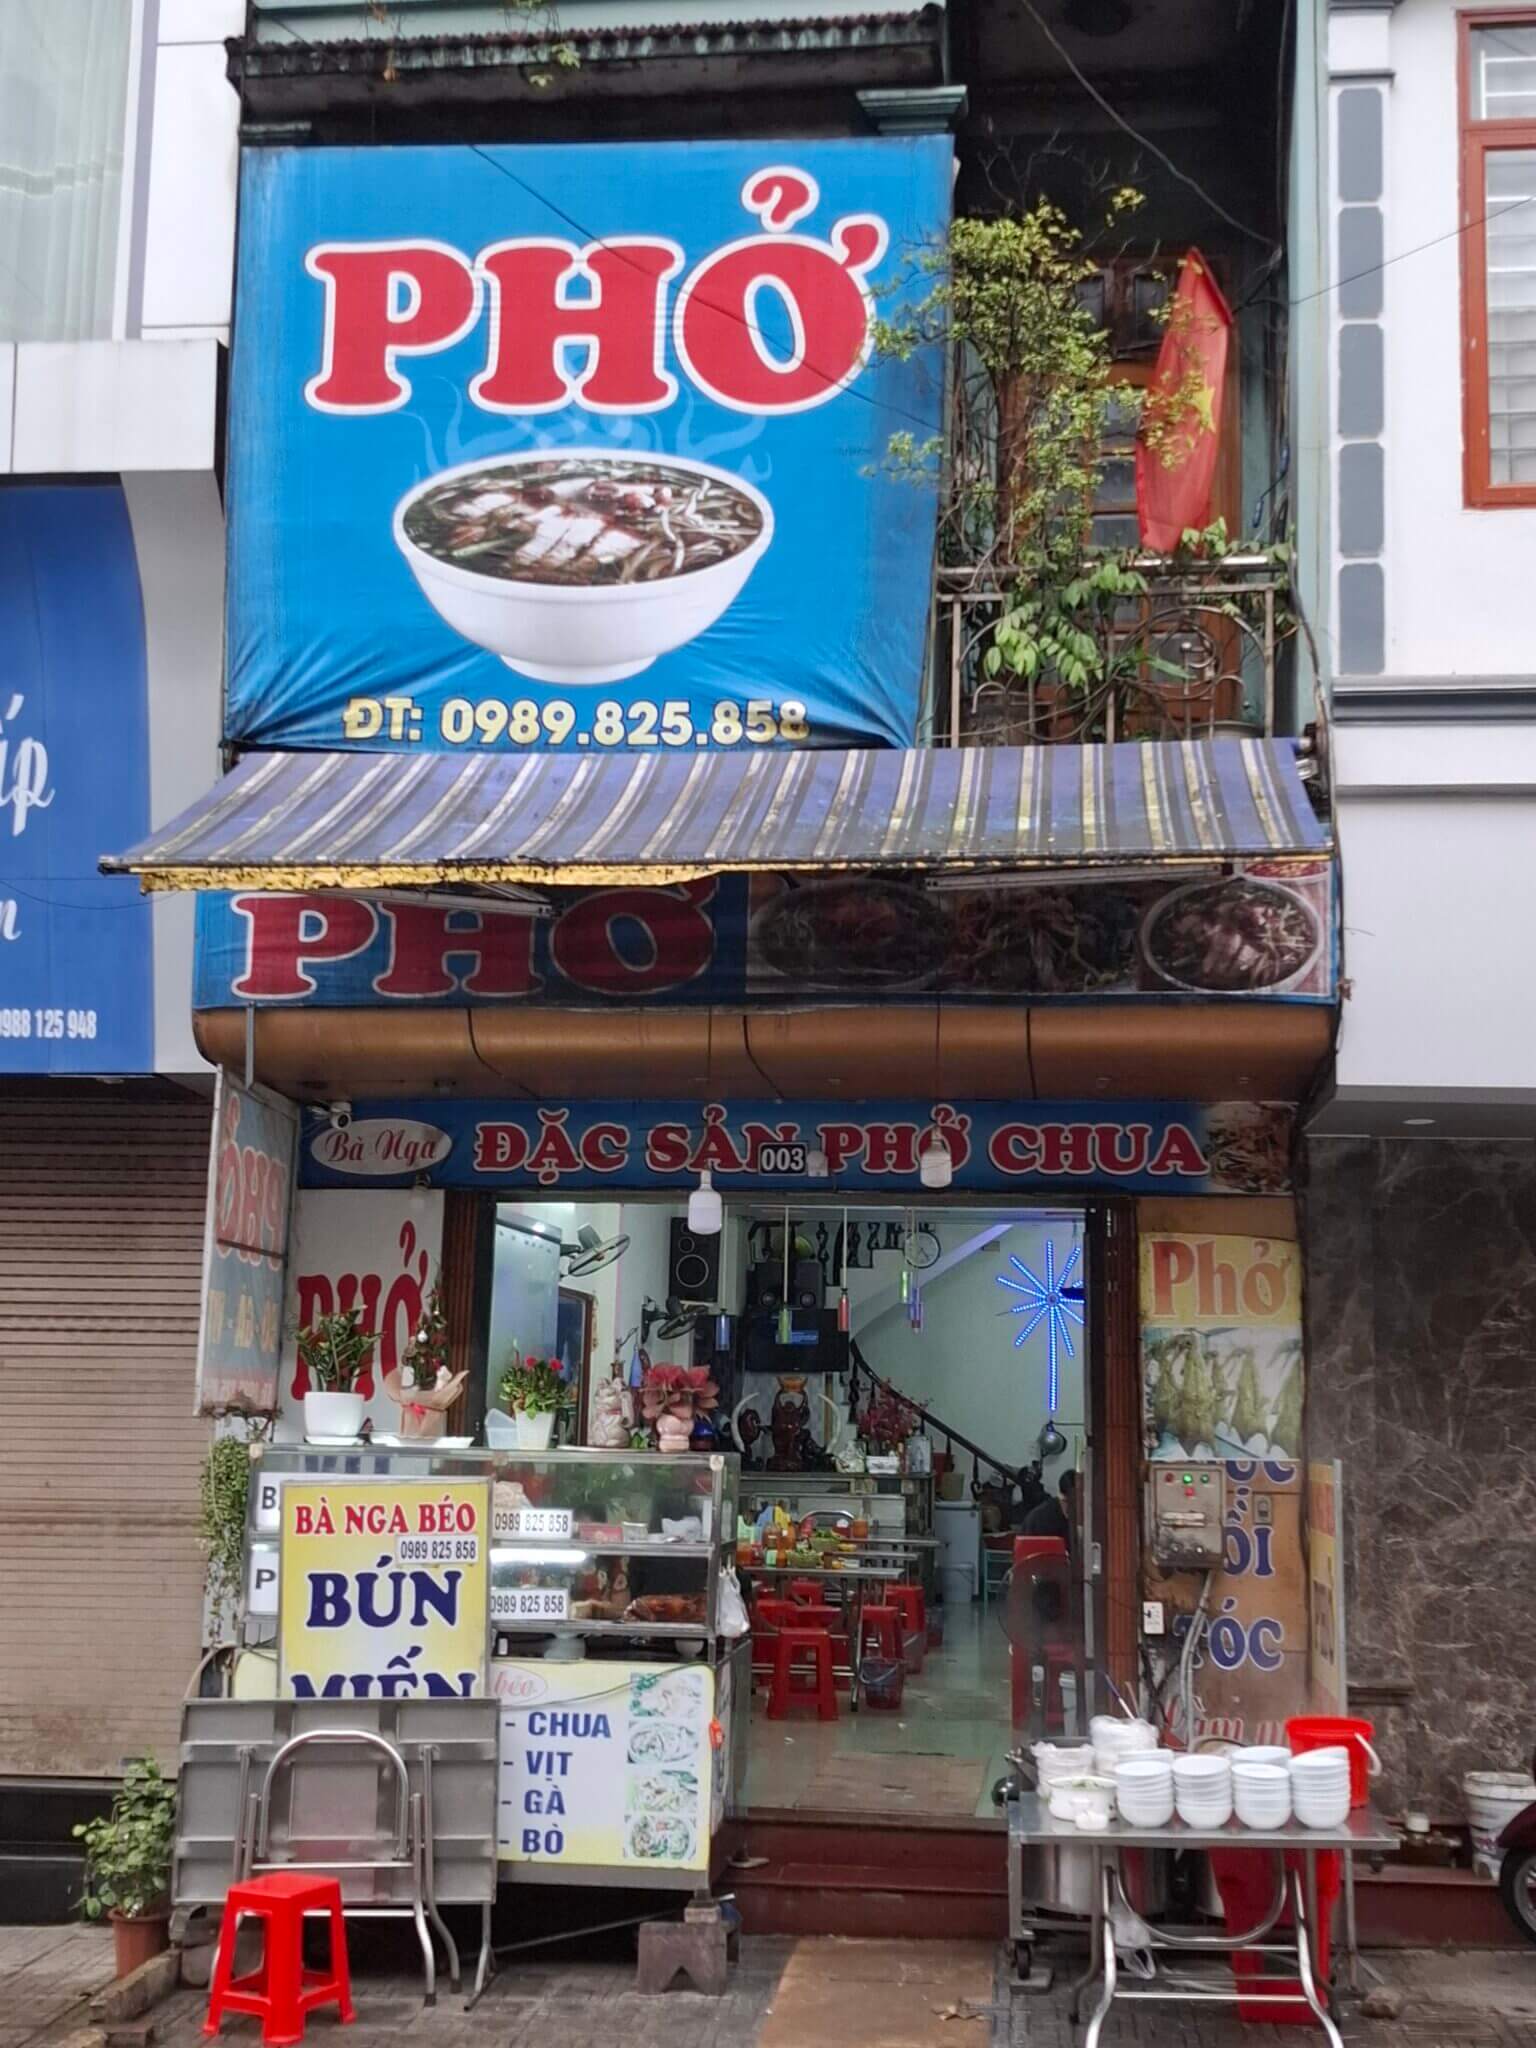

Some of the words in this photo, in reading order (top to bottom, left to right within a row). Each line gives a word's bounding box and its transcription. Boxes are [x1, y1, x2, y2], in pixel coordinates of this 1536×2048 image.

[305, 166, 889, 414] PHỞ
[341, 697, 422, 742] ĐT:
[439, 699, 810, 746] 0989.825.858
[0, 1009, 31, 1038] 988
[35, 1009, 64, 1038] 125
[67, 1010, 97, 1039] 948
[325, 1131, 365, 1163] Bà
[374, 1129, 440, 1165] Nga
[473, 1108, 631, 1184] ĐẶC
[646, 1103, 801, 1174] SẢN
[817, 1103, 973, 1174] PHỞ
[988, 1122, 1211, 1176] CHUA
[761, 1148, 804, 1172] 003
[1150, 1239, 1293, 1319] Phở
[295, 1496, 336, 1535] BÀ
[345, 1504, 409, 1534] NGA
[418, 1494, 478, 1534] BÉO
[494, 1512, 520, 1531] 0989
[525, 1513, 544, 1532] 825
[548, 1514, 569, 1532] 858
[400, 1541, 428, 1560] 0989
[431, 1541, 452, 1560] 825
[455, 1541, 477, 1559] 858
[306, 1555, 463, 1628] BÚN
[520, 1595, 540, 1613] 825
[543, 1595, 565, 1613] 858
[528, 1711, 612, 1738] CHUA
[526, 1750, 574, 1782] VỊT
[523, 1785, 566, 1815] GÀ
[522, 1823, 564, 1855] BÒ
